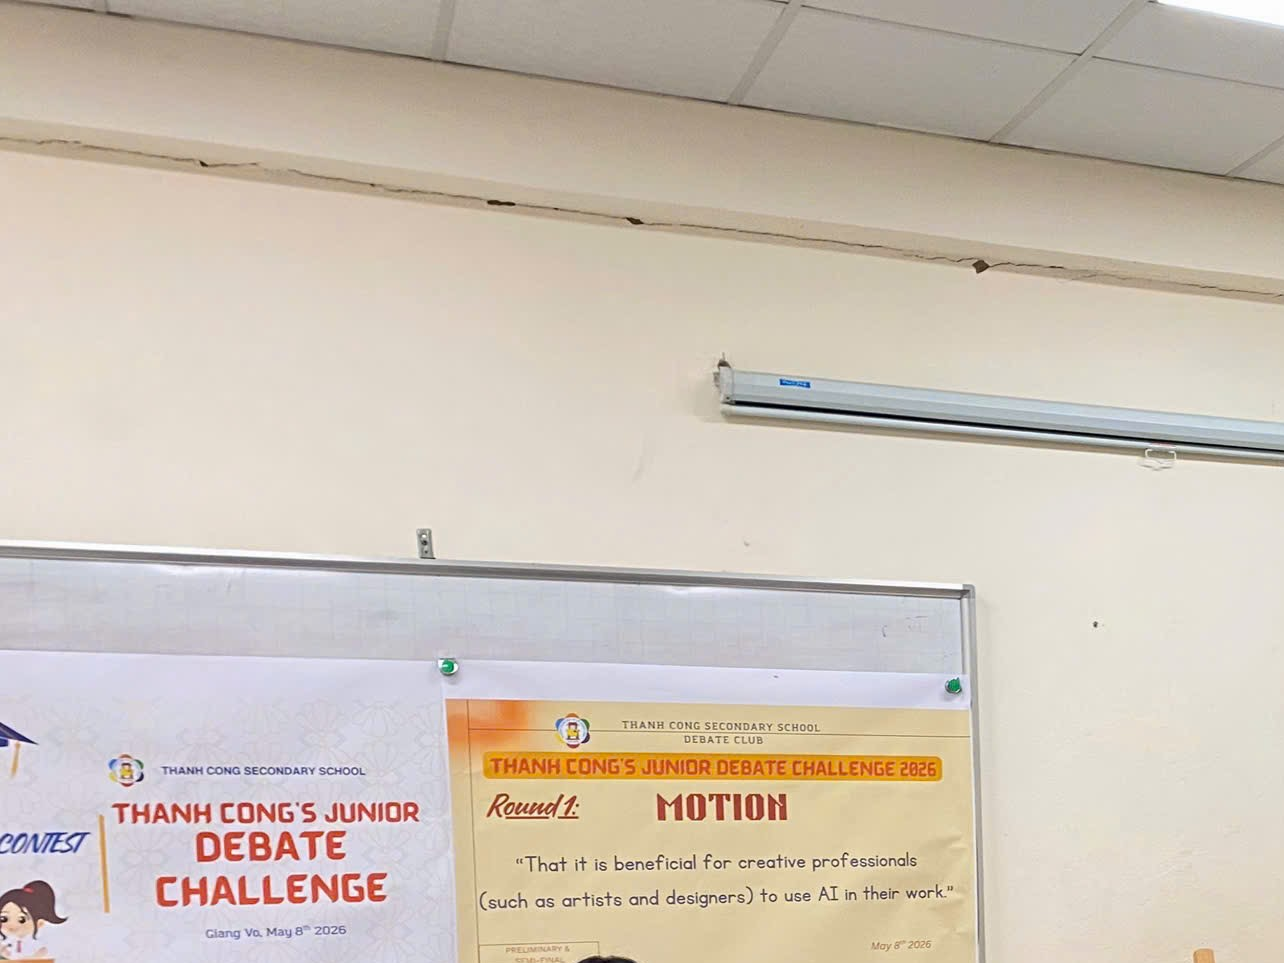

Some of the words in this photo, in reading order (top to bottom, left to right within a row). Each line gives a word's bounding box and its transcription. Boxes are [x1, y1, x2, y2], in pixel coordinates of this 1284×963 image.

[621, 720, 666, 730] THANH
[669, 721, 701, 731] CONG
[704, 722, 774, 732] SECONDARY
[777, 723, 821, 733] SCHOOL
[683, 735, 730, 745] DEBATE
[733, 736, 764, 745] CLUB
[161, 765, 203, 777] THANH
[206, 766, 241, 777] CONG
[244, 766, 316, 776] SECONDARY
[318, 766, 367, 776] SCHOOL
[490, 757, 561, 775] THANH
[566, 757, 636, 776] CONG'S
[642, 759, 711, 776] JUNIOR
[716, 760, 787, 777] DEBATE
[792, 760, 896, 777] CHALLENGE
[899, 762, 937, 777] 2026
[112, 803, 212, 824] THANH
[220, 802, 317, 824] CONG'S
[325, 802, 420, 824] JUNIOR
[486, 793, 564, 819] Round
[561, 794, 580, 819] 1:
[656, 793, 788, 821] MOTION
[0, 832, 91, 854] CONTEST
[196, 830, 348, 863] DEBATE
[574, 857, 587, 871] it
[594, 858, 608, 871] is
[614, 854, 697, 871] beneficial
[703, 854, 732, 870] for
[738, 854, 806, 869] creative
[812, 852, 918, 872] professionals
[156, 873, 389, 908] CHALLENGE
[479, 891, 528, 911] (such
[535, 898, 555, 908] as
[562, 892, 622, 907] artists
[629, 889, 659, 906] and
[666, 886, 754, 908] designers)
[760, 888, 778, 903] to
[784, 891, 812, 902] use
[818, 886, 840, 901] AI
[844, 888, 858, 901] in
[863, 885, 900, 900] their
[205, 929, 241, 940] Giang
[266, 928, 292, 939] May
[314, 925, 347, 936] 2026
[505, 945, 562, 954] PRELIMINARY
[870, 941, 893, 952] May
[907, 940, 933, 949] 2026
